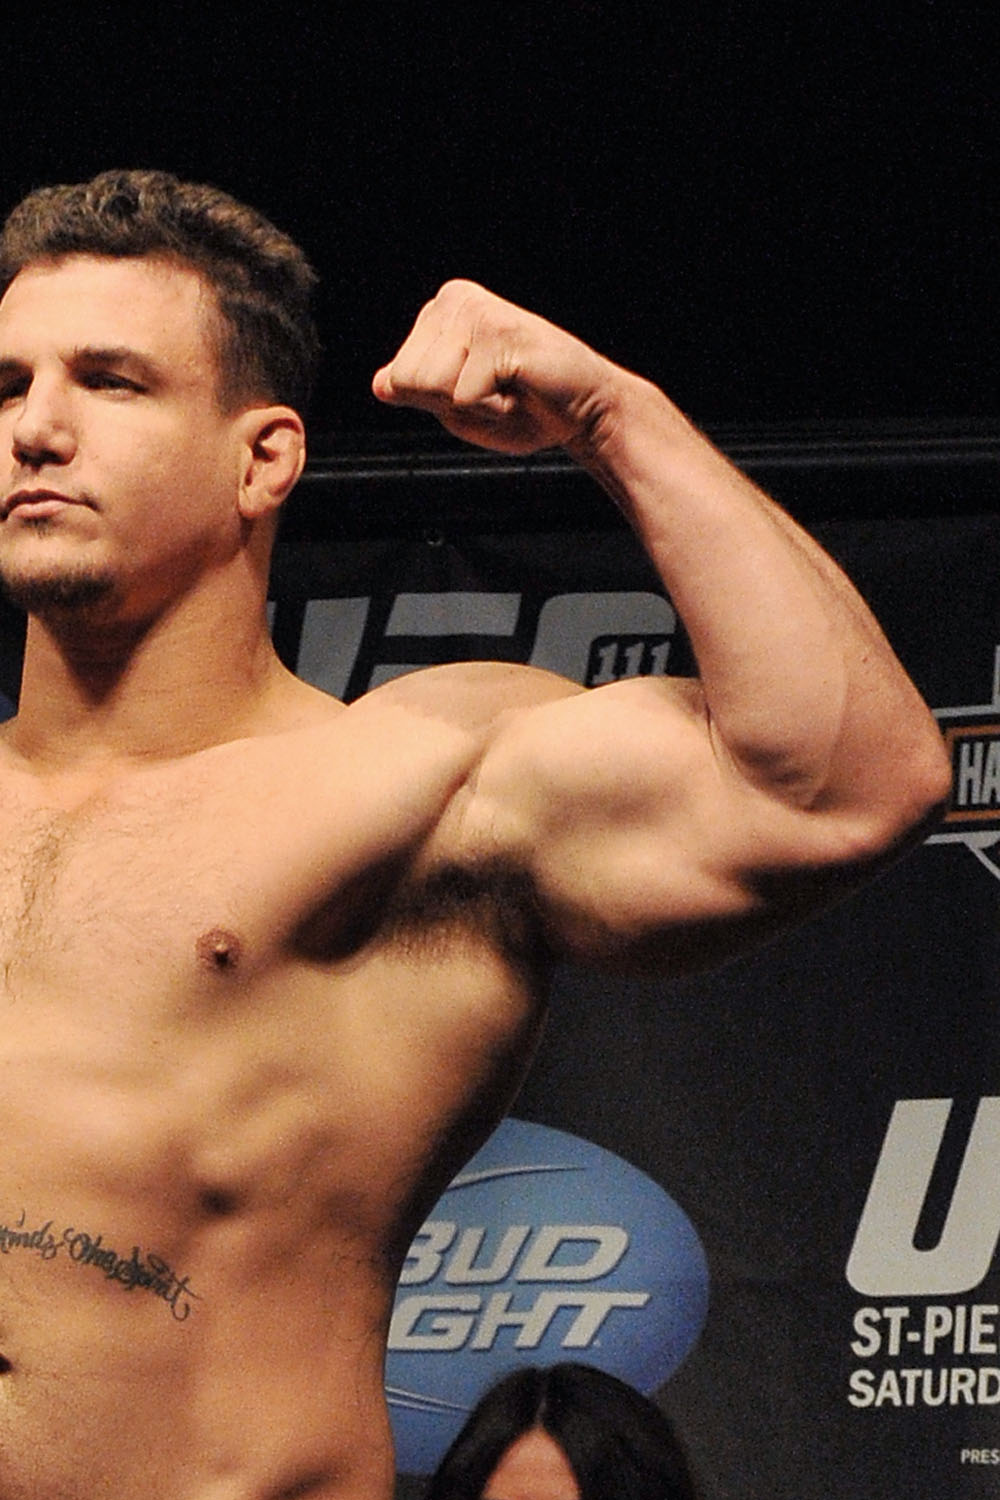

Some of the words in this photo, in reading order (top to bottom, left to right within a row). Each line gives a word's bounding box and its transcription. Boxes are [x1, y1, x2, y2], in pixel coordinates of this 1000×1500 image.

[592, 641, 672, 684] 111
[398, 1221, 628, 1286] BUD
[386, 1291, 650, 1351] GHT
[851, 1304, 1000, 1358] ST-PIE
[848, 1367, 1000, 1408] SATURD
